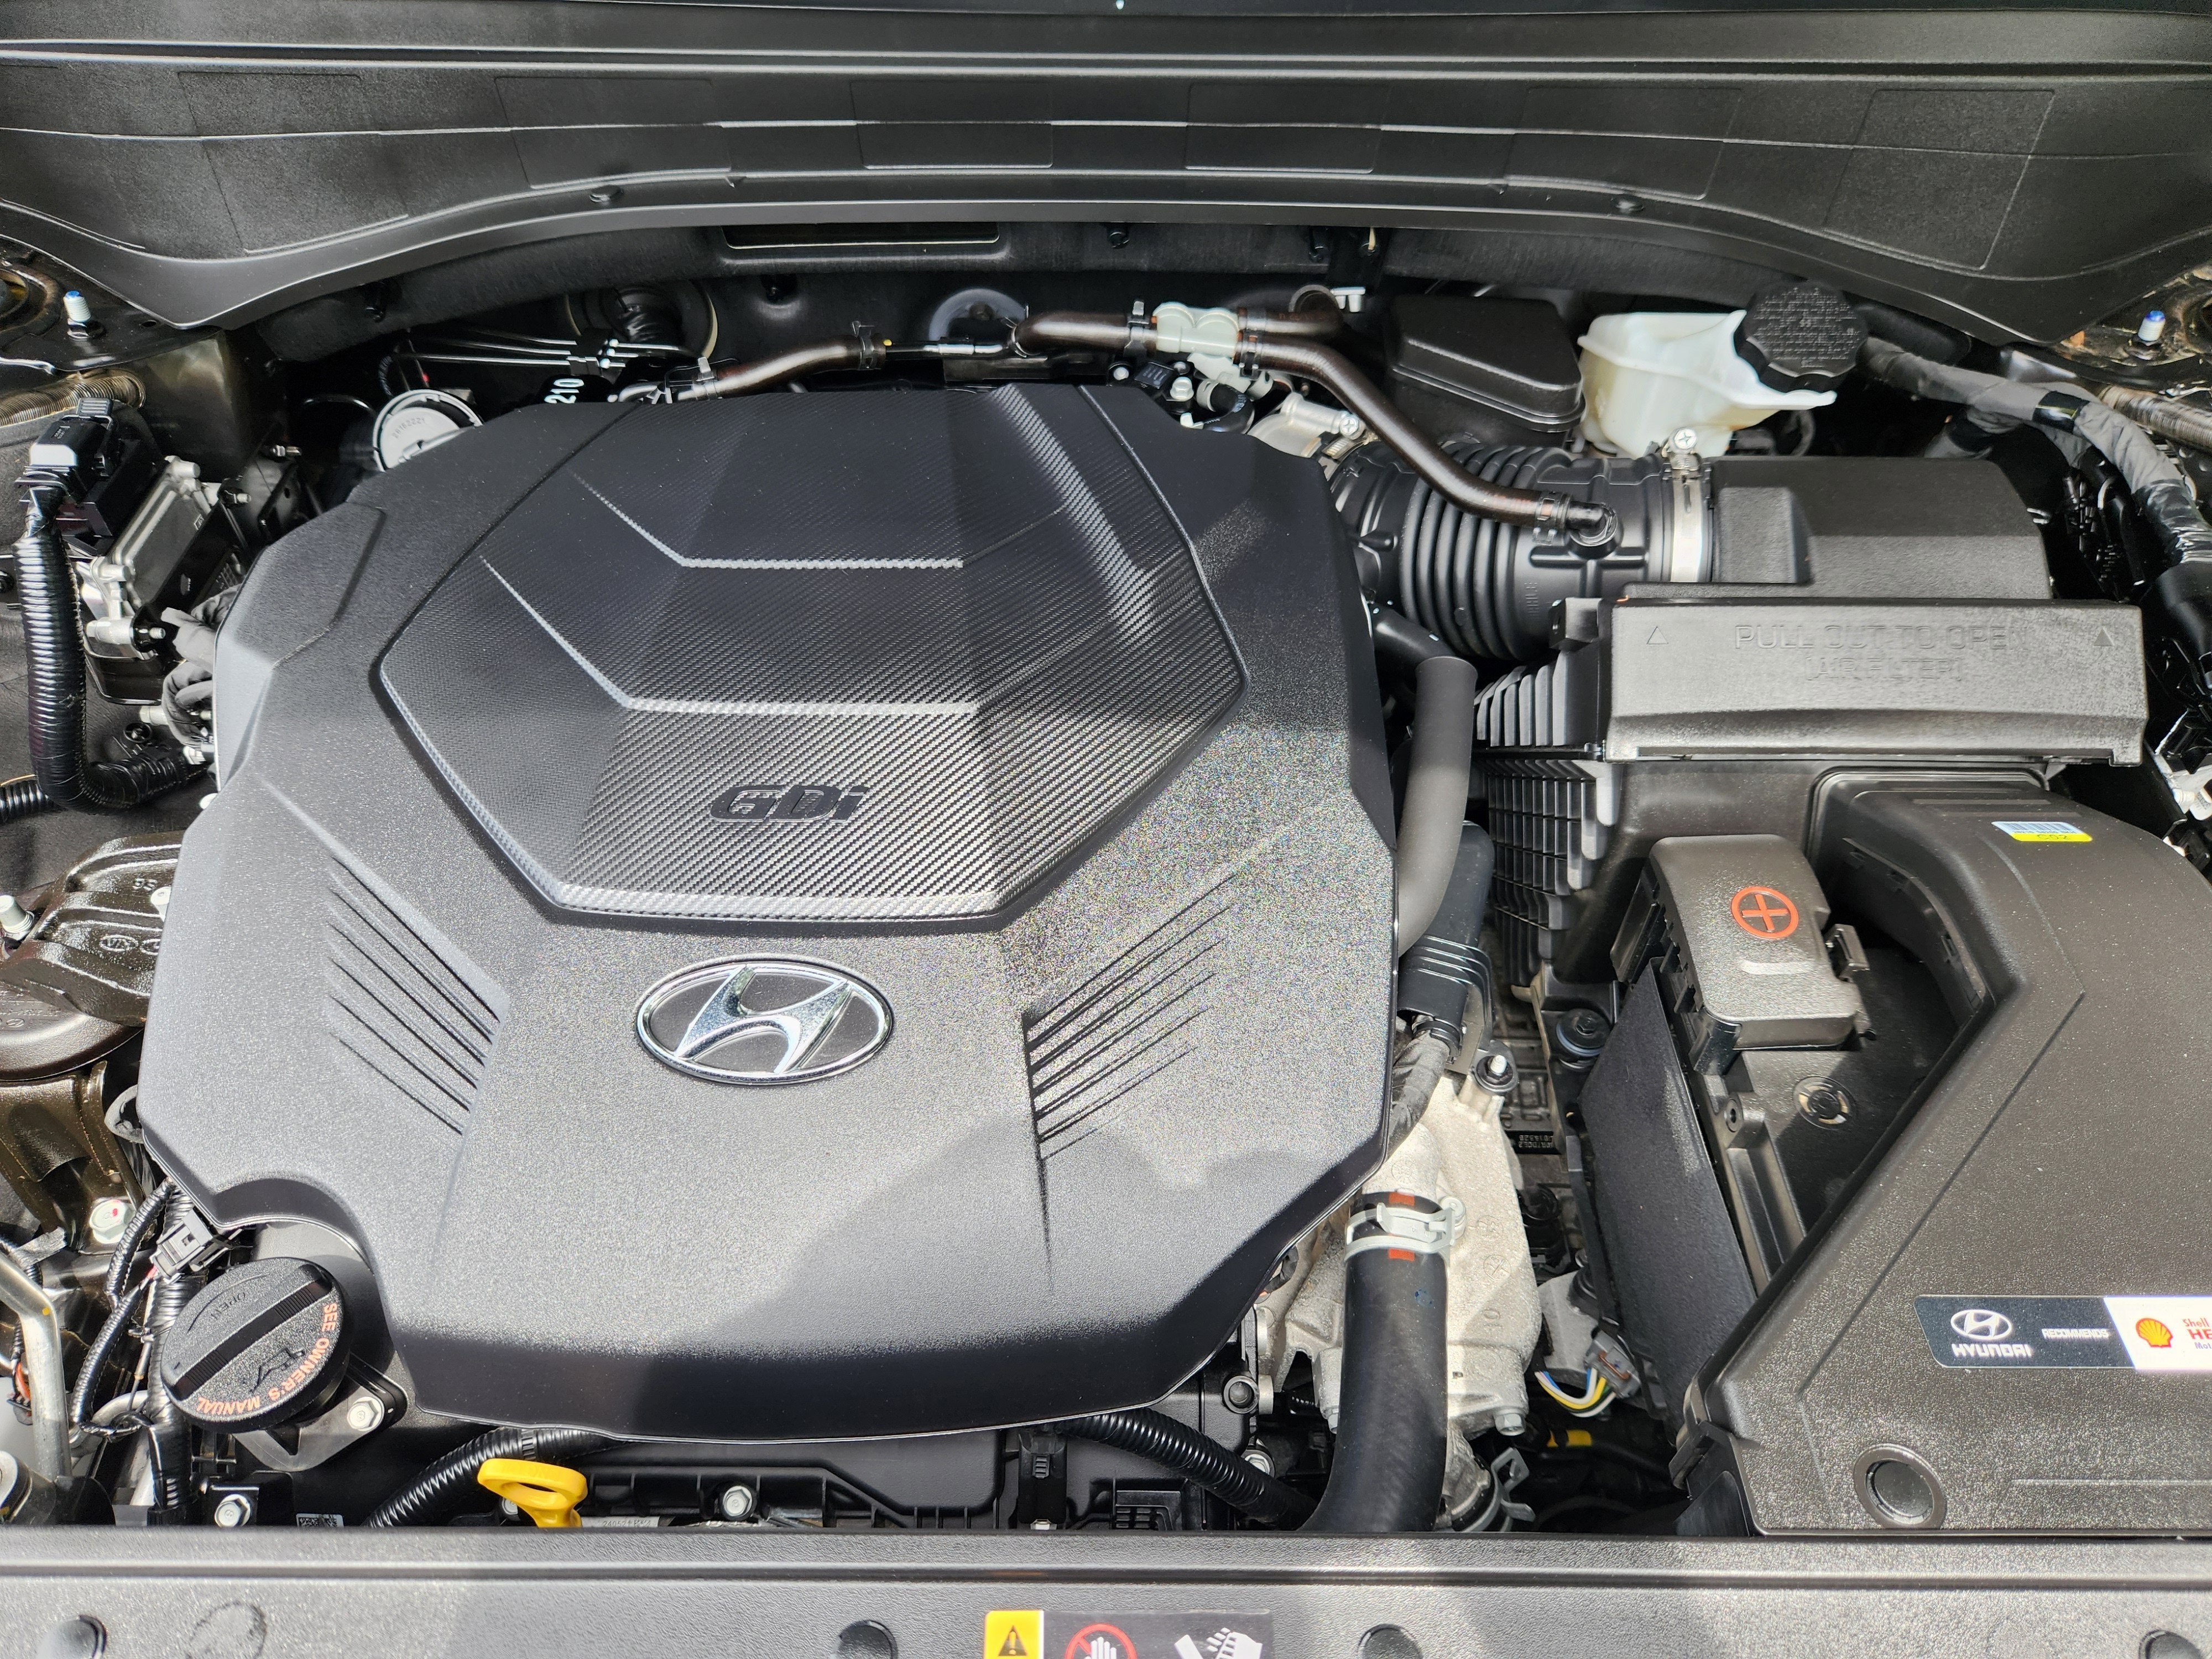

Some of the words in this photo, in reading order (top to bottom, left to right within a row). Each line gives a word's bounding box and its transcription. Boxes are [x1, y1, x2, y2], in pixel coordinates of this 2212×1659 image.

[1735, 625, 1815, 649] PULL
[1824, 625, 1885, 649] OUT
[1895, 625, 1935, 649] TO
[1946, 626, 2028, 650] OPEN
[710, 784, 869, 822] GDi
[210, 1291, 246, 1321] OPEN
[321, 1303, 337, 1332] SEE
[2041, 1328, 2110, 1339] RECOMMENDS
[2182, 1317, 2209, 1327] Shell
[1951, 1343, 2033, 1358] HYUNDAI
[268, 1337, 330, 1401] OWNER'S
[196, 1395, 260, 1415] MANUAL
